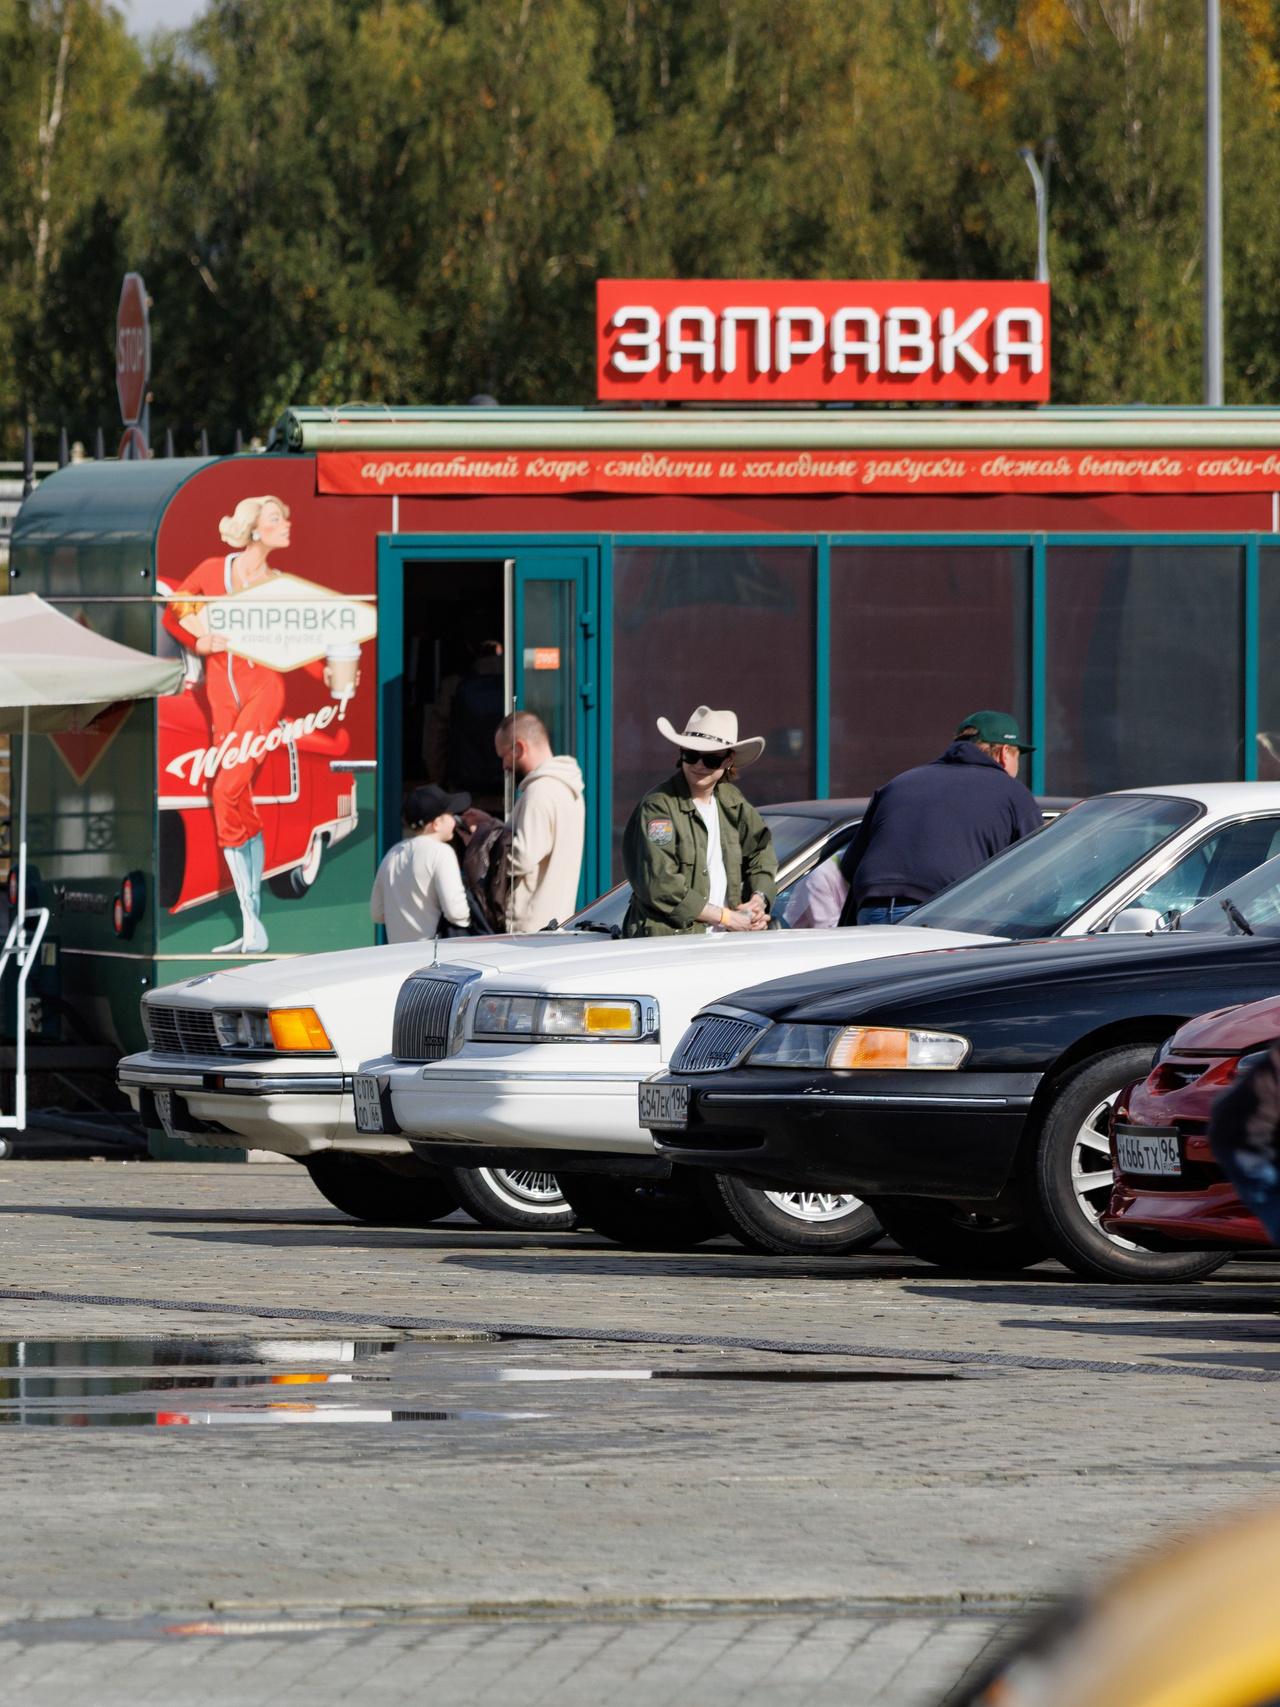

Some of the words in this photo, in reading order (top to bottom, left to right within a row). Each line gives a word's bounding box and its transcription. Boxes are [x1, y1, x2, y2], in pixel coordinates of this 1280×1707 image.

[118, 328, 144, 373] STOP
[612, 305, 1044, 374] ЗАПРАВКА
[360, 456, 520, 486] ароматный
[524, 457, 591, 483] кофе
[603, 453, 714, 478] сэндвичи
[719, 462, 738, 478] и
[741, 453, 859, 478] холодные
[862, 457, 967, 485] закуски
[980, 455, 1072, 477] свежая
[1077, 455, 1184, 477] выпечка
[210, 608, 357, 631] ЗАПРАВКА
[165, 681, 355, 786] Welcome!
[671, 1087, 686, 1110] 196
[1161, 1138, 1176, 1162] 96
